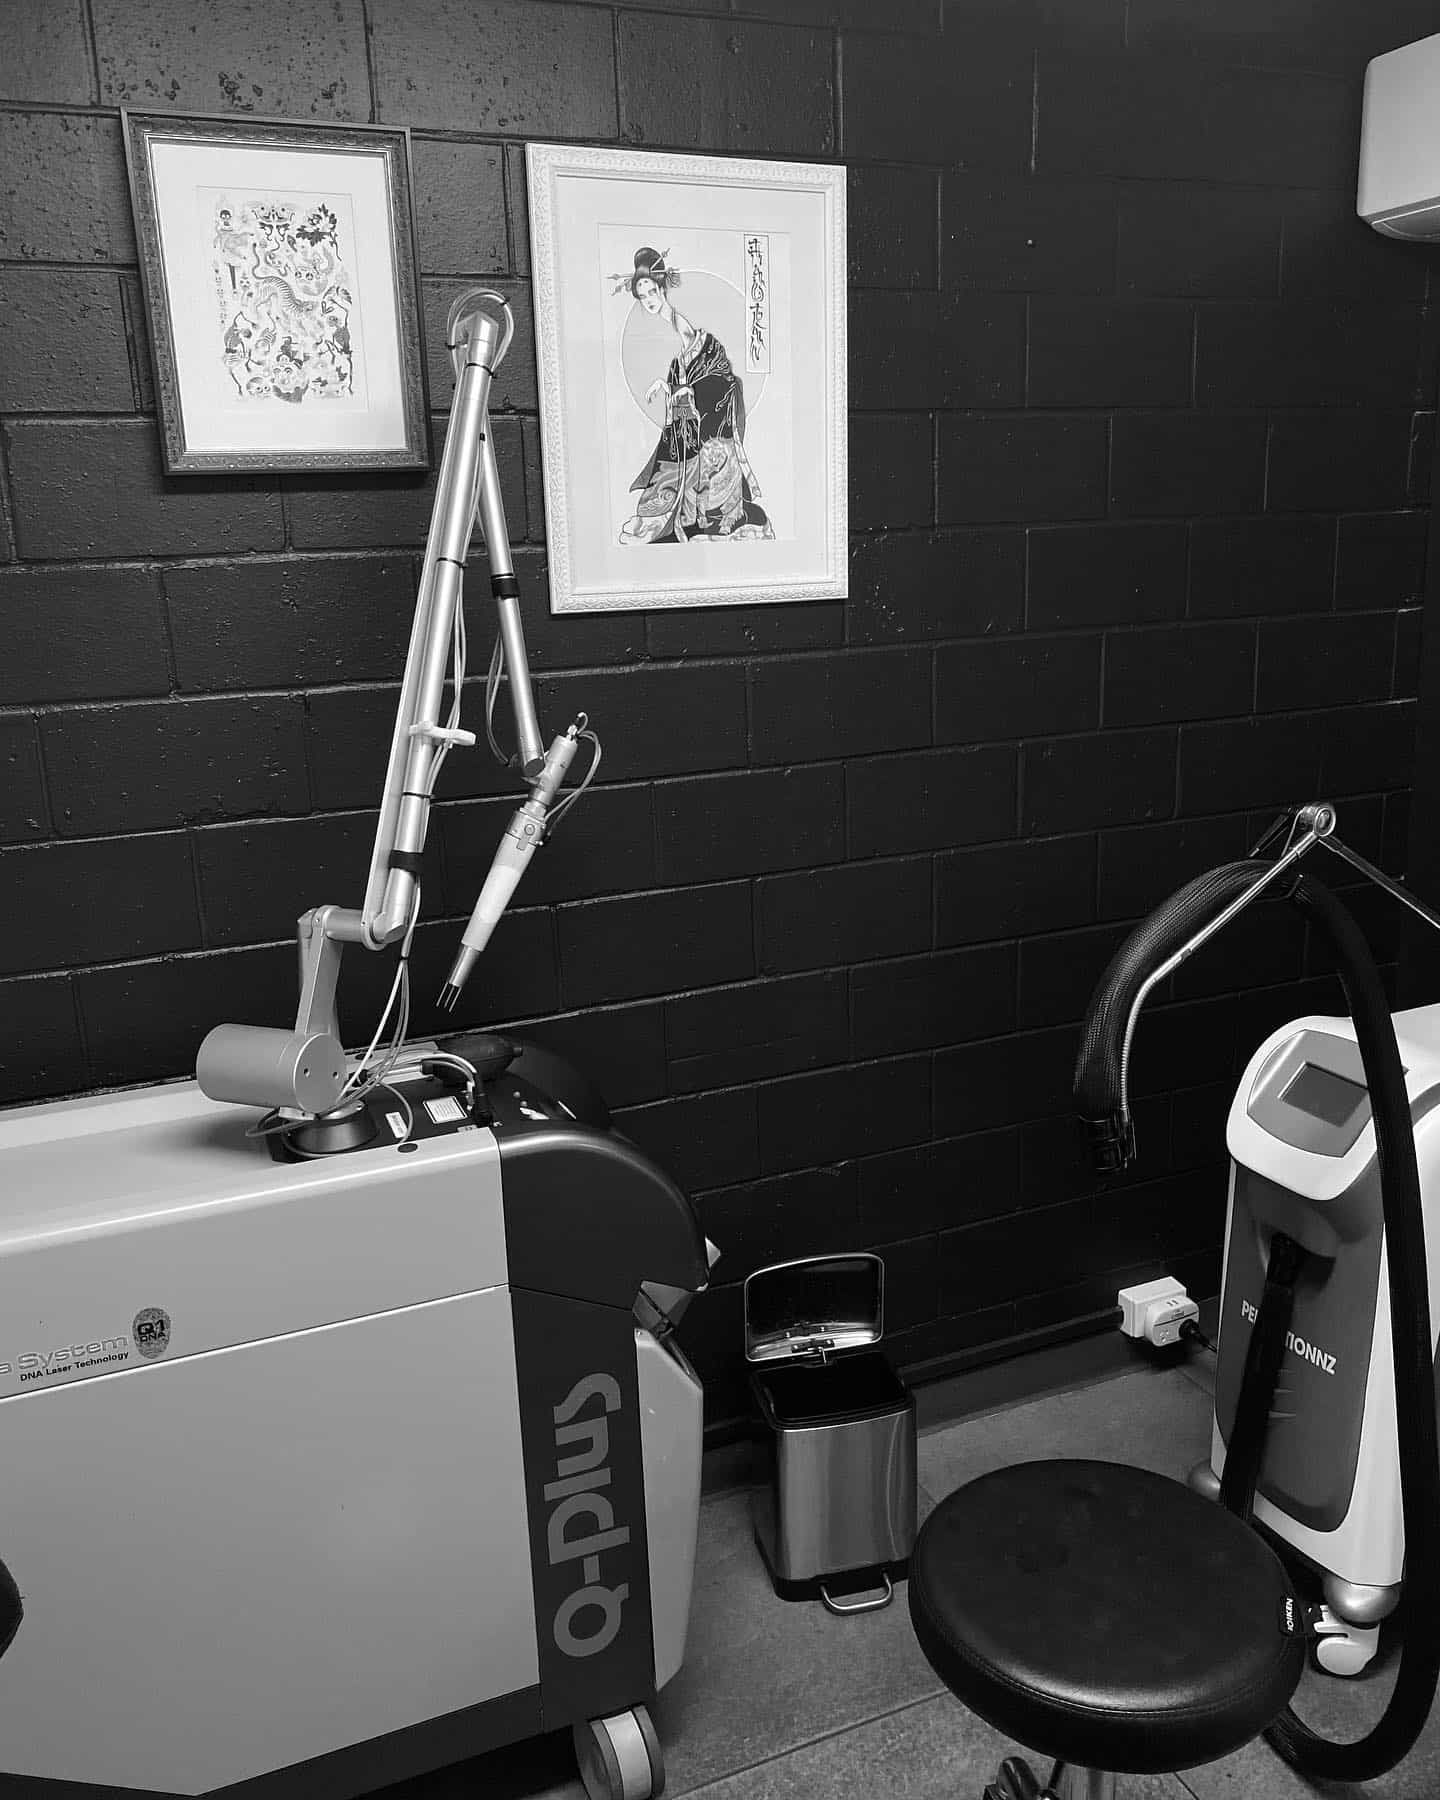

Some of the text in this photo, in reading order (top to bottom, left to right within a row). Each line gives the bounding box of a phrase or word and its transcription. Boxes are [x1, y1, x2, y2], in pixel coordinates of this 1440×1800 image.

[137, 1319, 165, 1336] Q1
[139, 1331, 166, 1343] DNA
[18, 1335, 129, 1371] System
[20, 1351, 129, 1382] DNA Laser Technology
[543, 1372, 631, 1658] Q-plus
